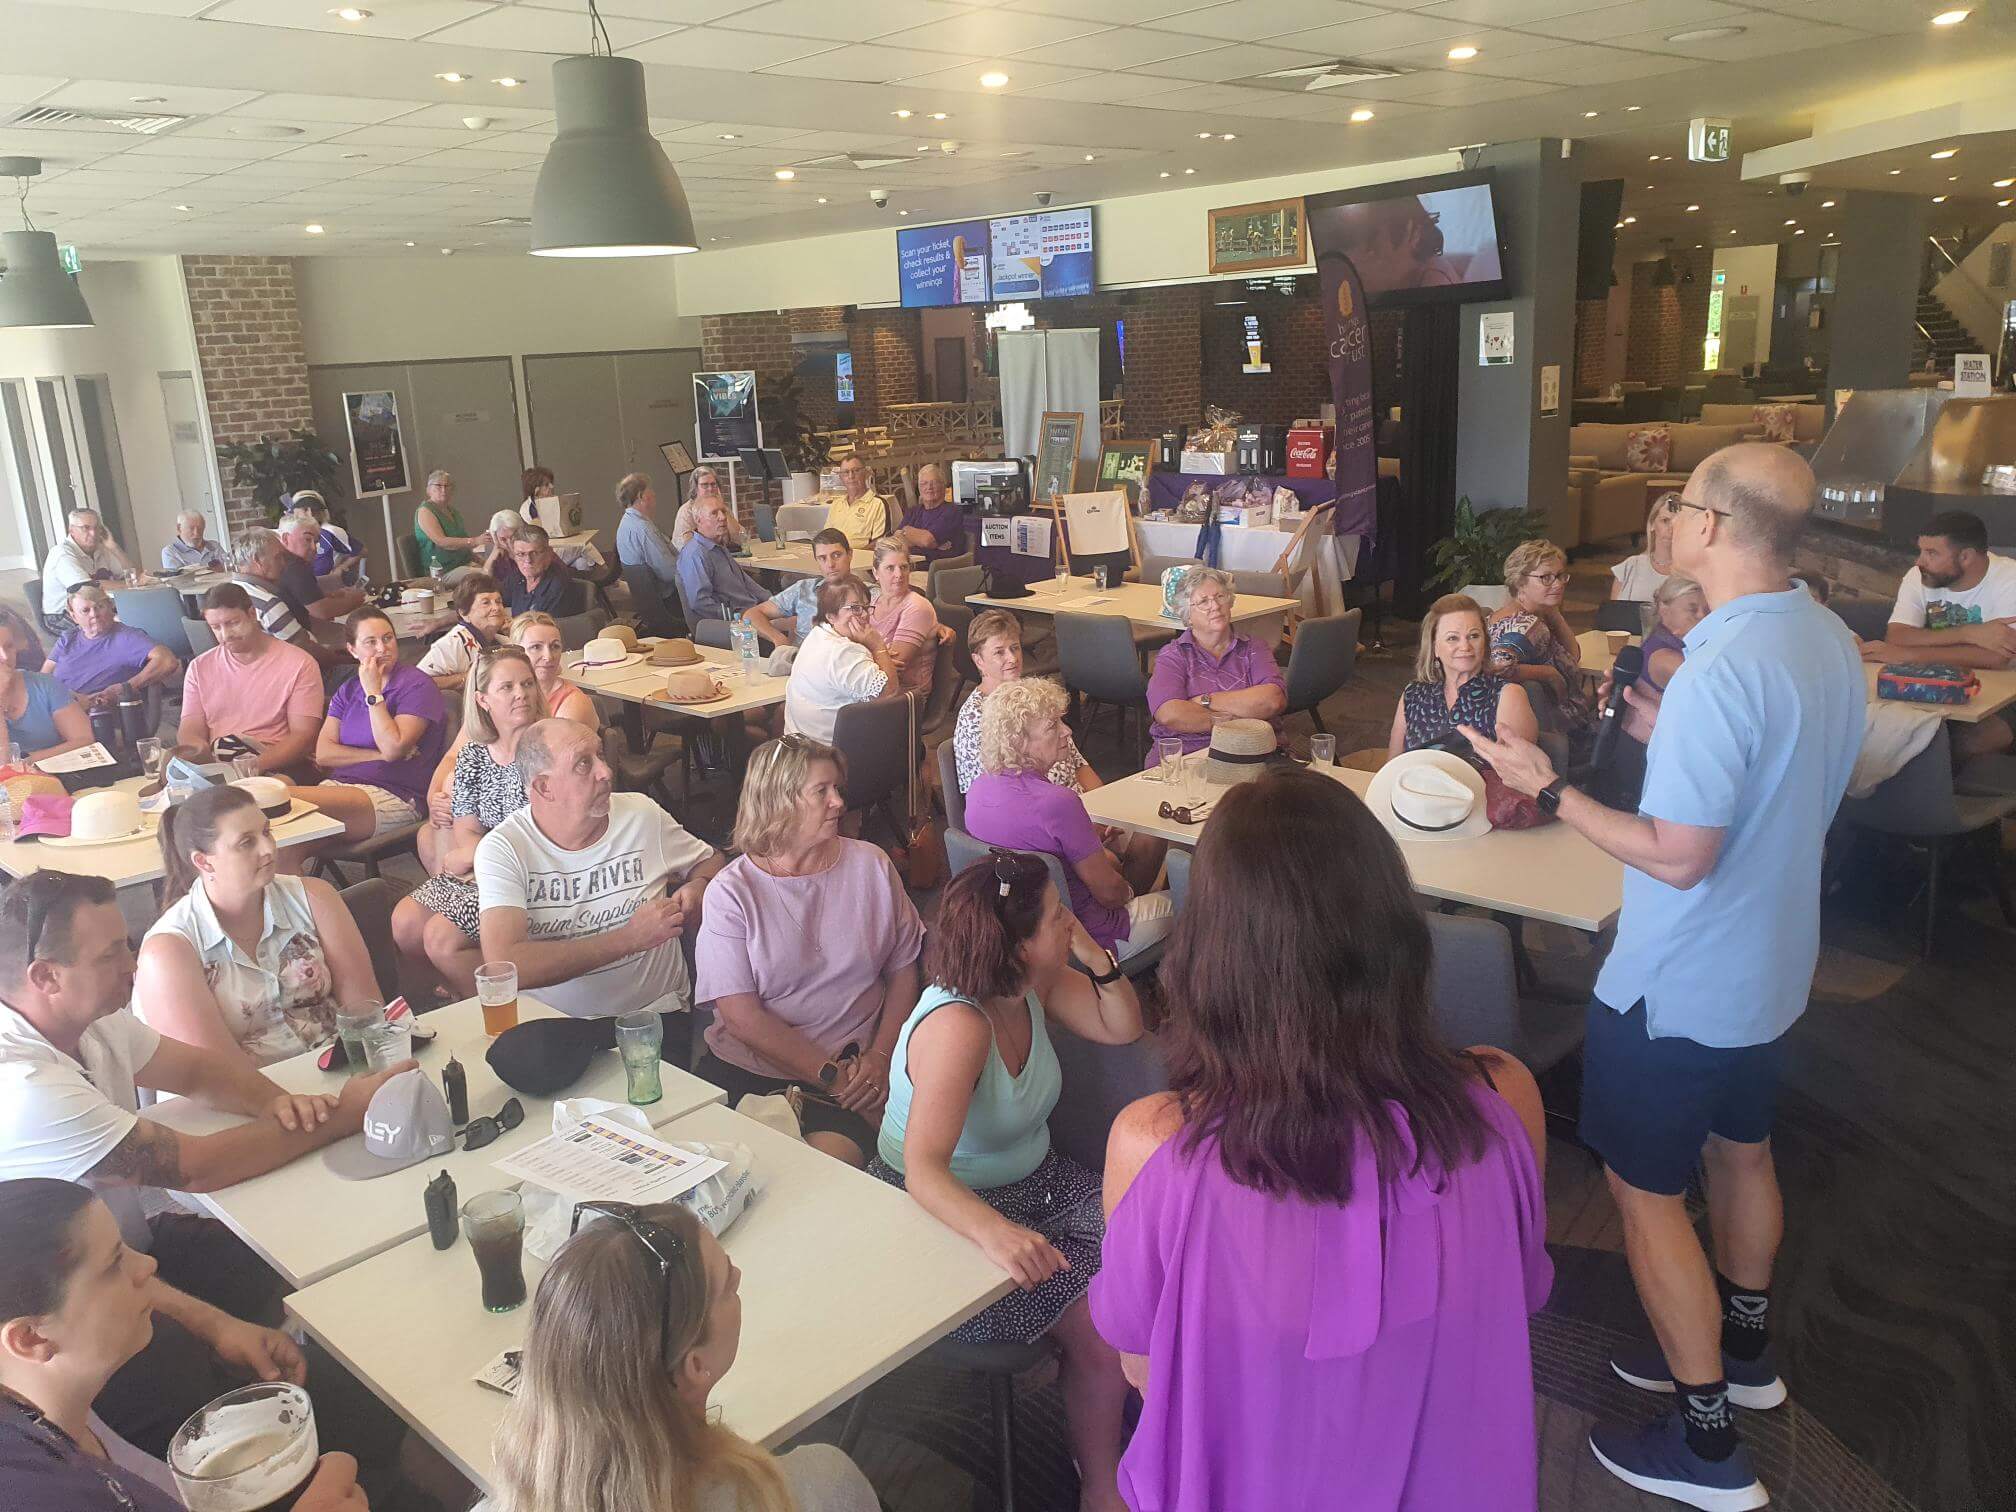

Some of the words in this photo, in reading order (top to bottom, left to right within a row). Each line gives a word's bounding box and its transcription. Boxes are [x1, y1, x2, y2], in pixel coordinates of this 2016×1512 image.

[901, 249, 916, 258] Scan
[917, 245, 931, 257] your
[904, 259, 922, 270] check
[923, 251, 945, 264] results
[945, 250, 951, 260] &
[910, 267, 931, 280] collect
[932, 264, 947, 276] your
[916, 278, 942, 289] winnings
[1963, 360, 1983, 369] WATER
[1960, 371, 1986, 382] STATION
[526, 877, 582, 903] EAGLE
[588, 857, 645, 895] RIVER
[527, 917, 572, 935] Denim
[365, 1115, 403, 1145] LEY
